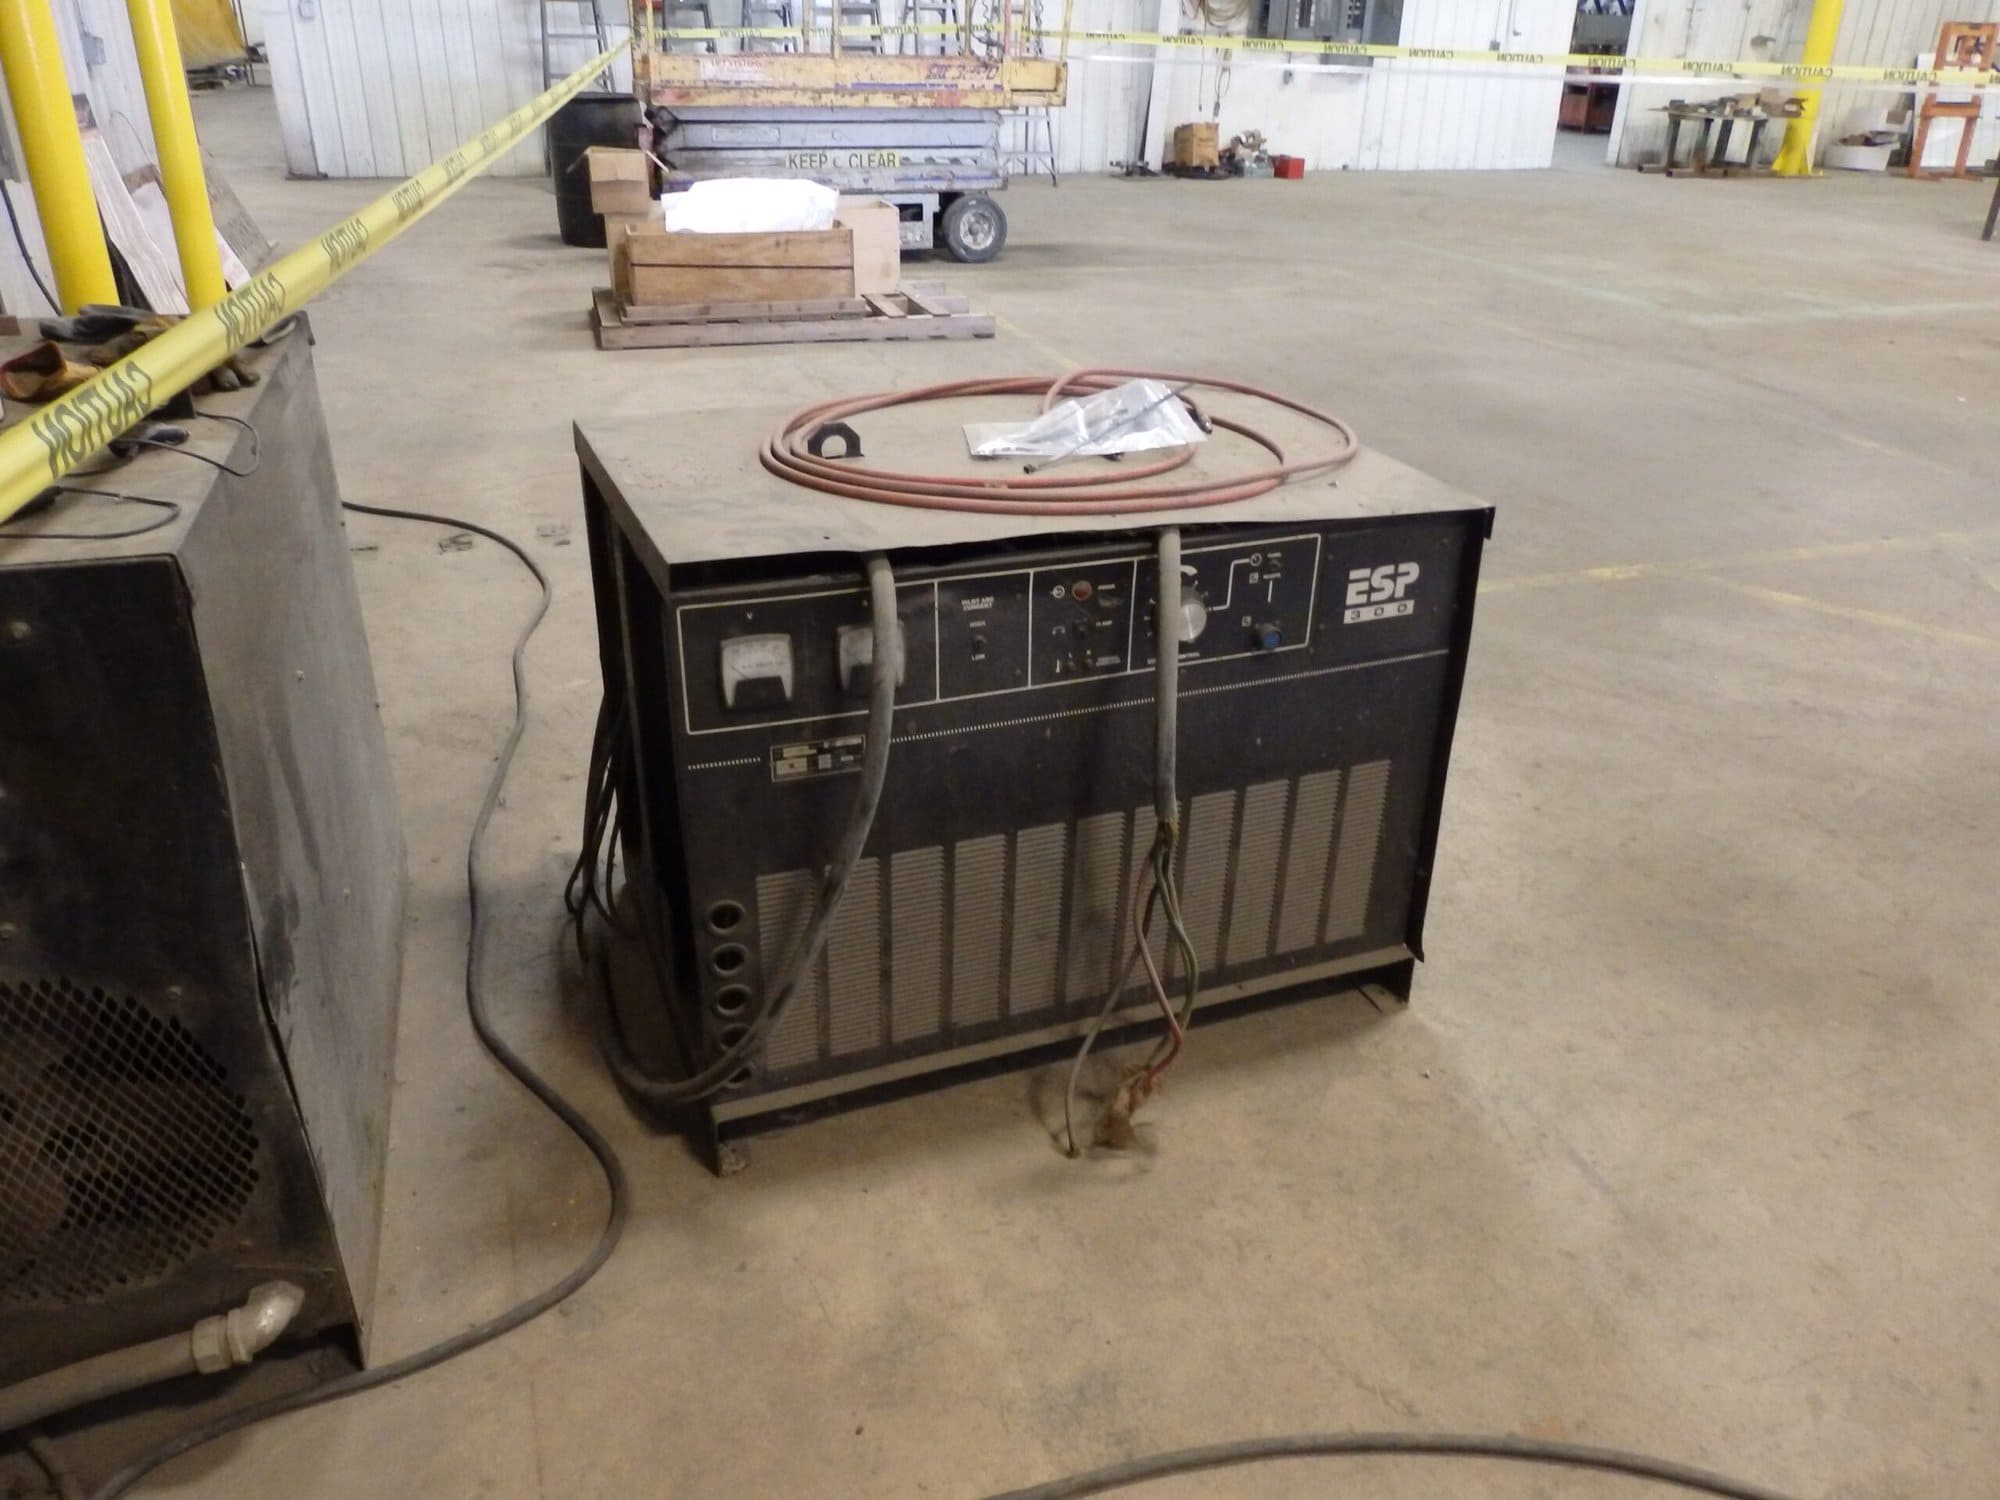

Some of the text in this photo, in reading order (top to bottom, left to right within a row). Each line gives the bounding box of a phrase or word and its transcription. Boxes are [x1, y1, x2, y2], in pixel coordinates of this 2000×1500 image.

[788, 153, 896, 168] KEEP CLEAR
[1346, 562, 1419, 606] ESP
[1349, 602, 1409, 621] 300
